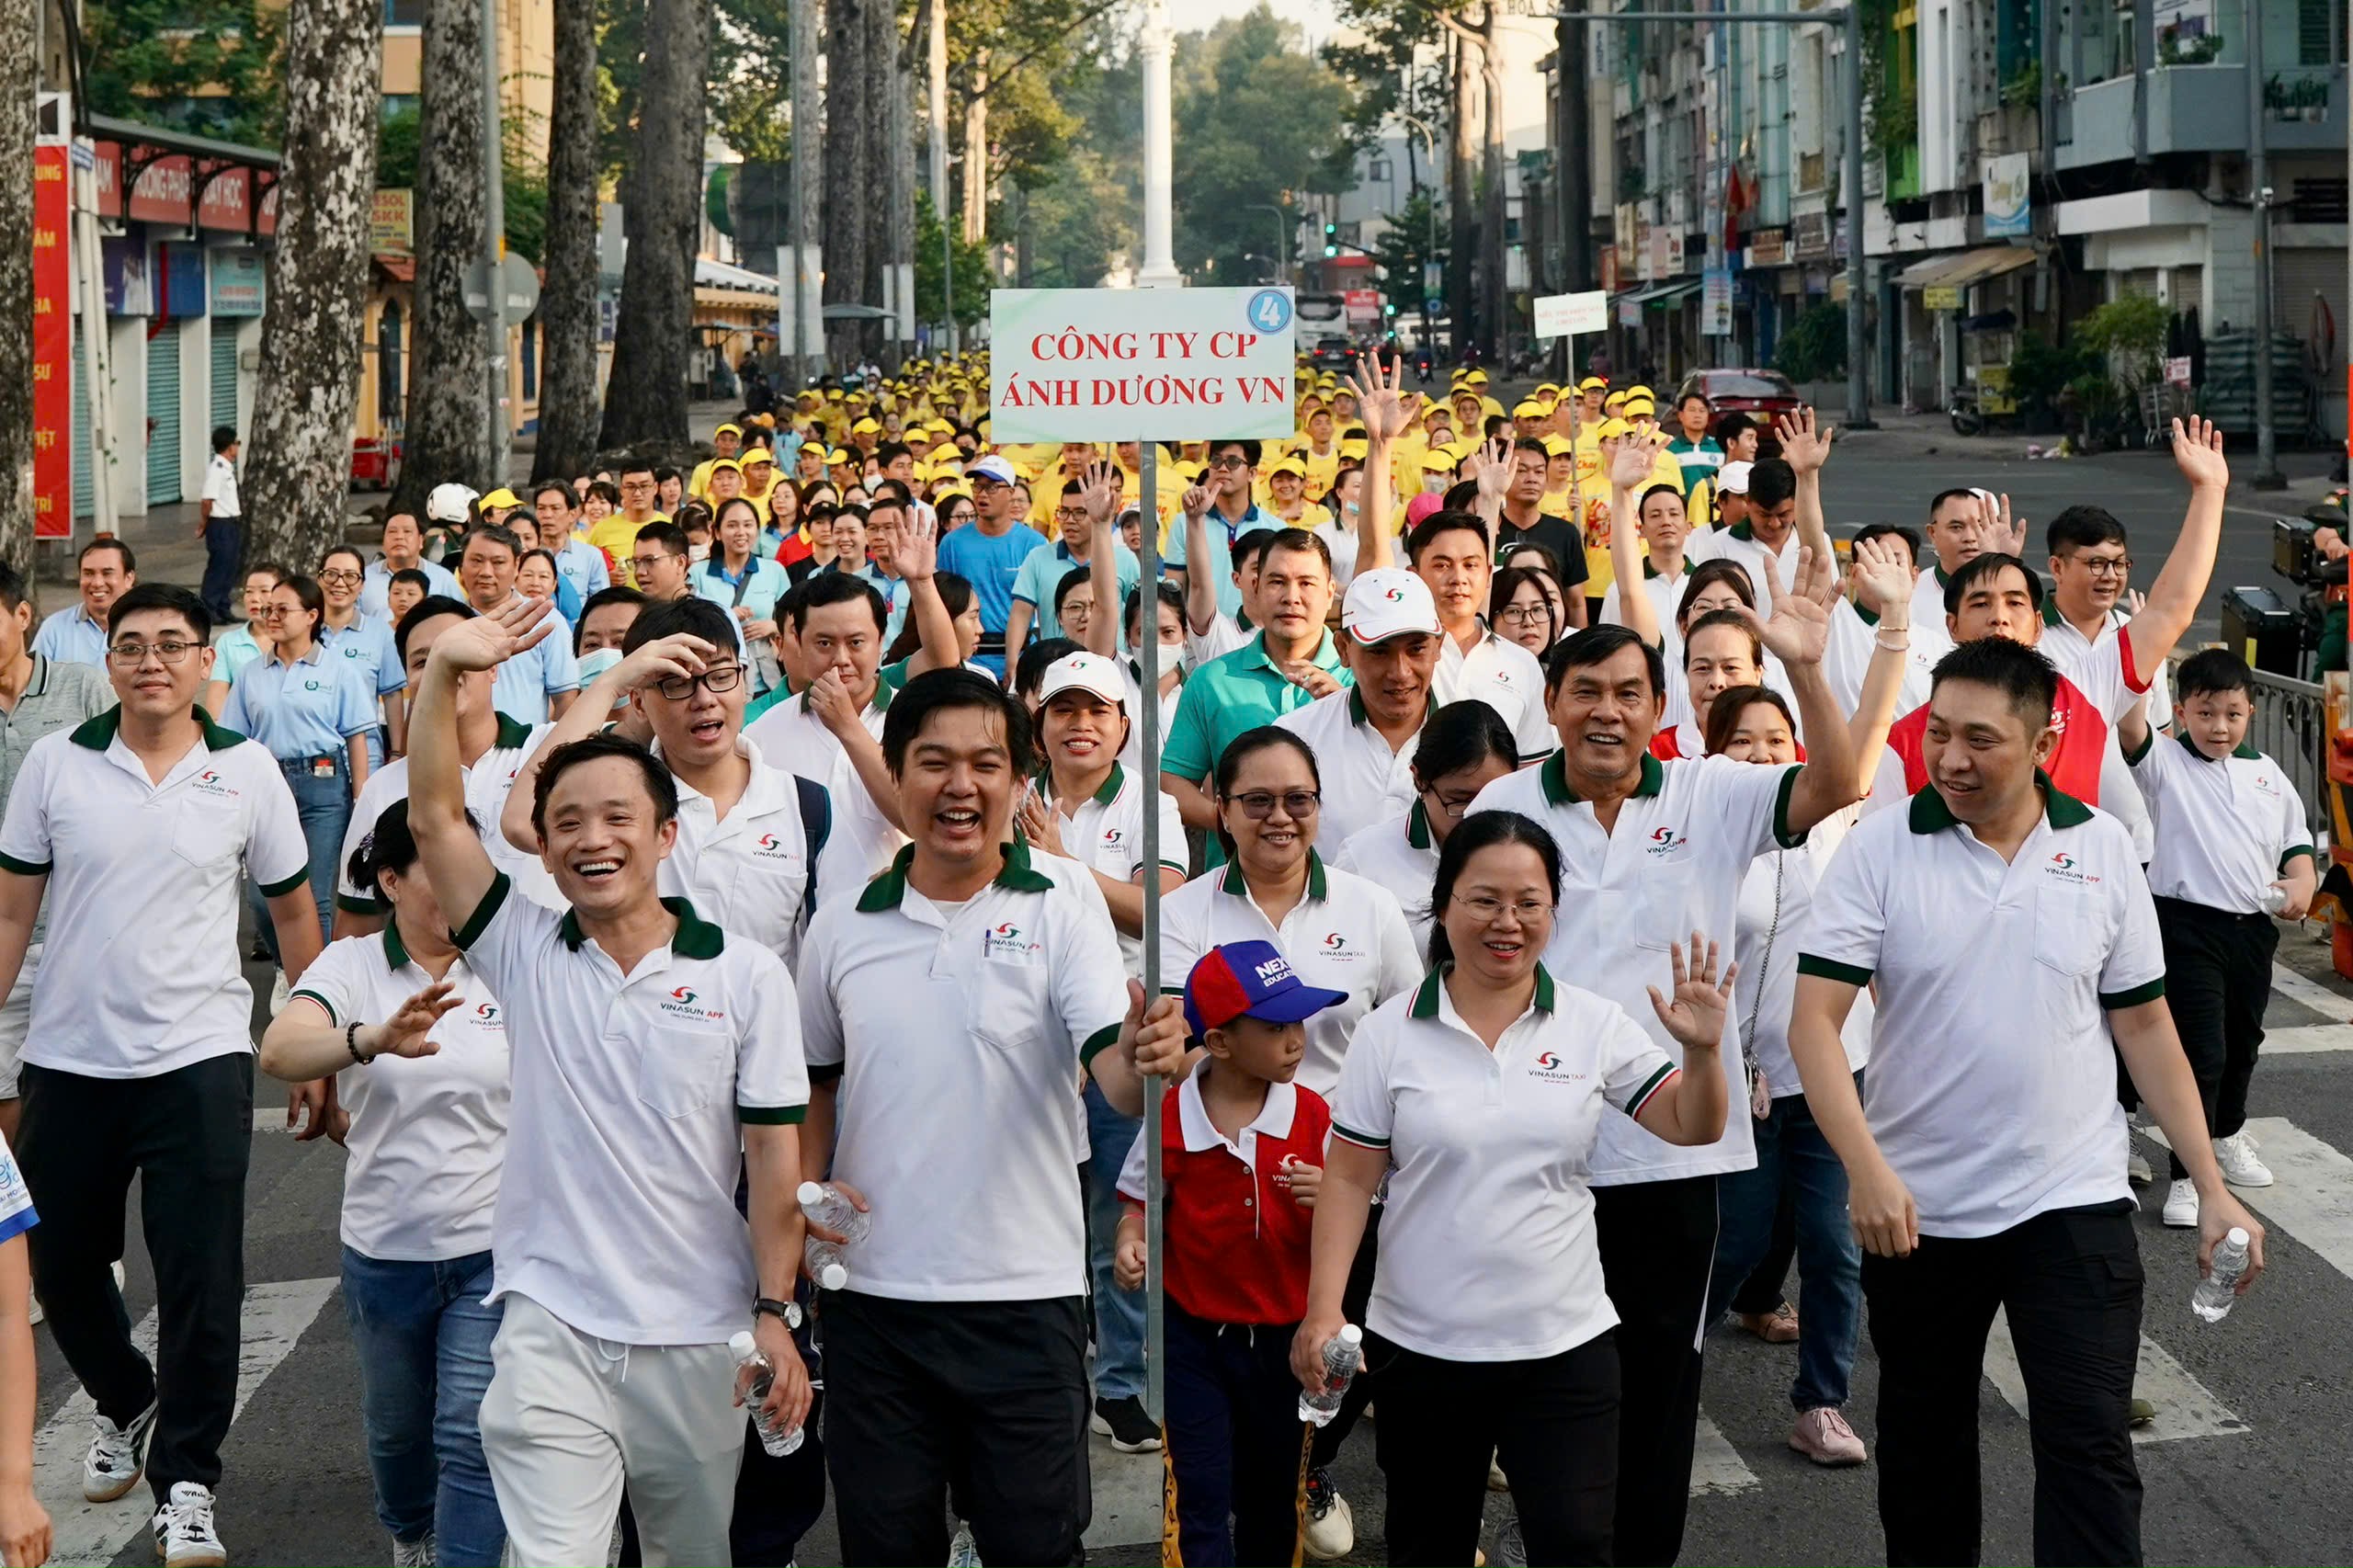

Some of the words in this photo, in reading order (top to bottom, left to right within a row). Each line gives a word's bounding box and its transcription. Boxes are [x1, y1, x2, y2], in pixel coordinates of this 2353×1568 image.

[35, 165, 62, 181] UNG
[34, 227, 55, 247] ÂM
[1258, 296, 1281, 326] 4
[1031, 325, 1139, 360] CÔNG
[1150, 332, 1199, 358] TY
[1210, 331, 1256, 358] CP
[1000, 371, 1080, 407] ÁNH
[1091, 374, 1225, 406] DƯƠNG
[1235, 377, 1286, 403] VN
[35, 426, 56, 451] IỆT
[660, 1003, 704, 1016] VINASUN
[707, 1010, 724, 1018] APP
[1529, 1070, 1570, 1079] VINASUN
